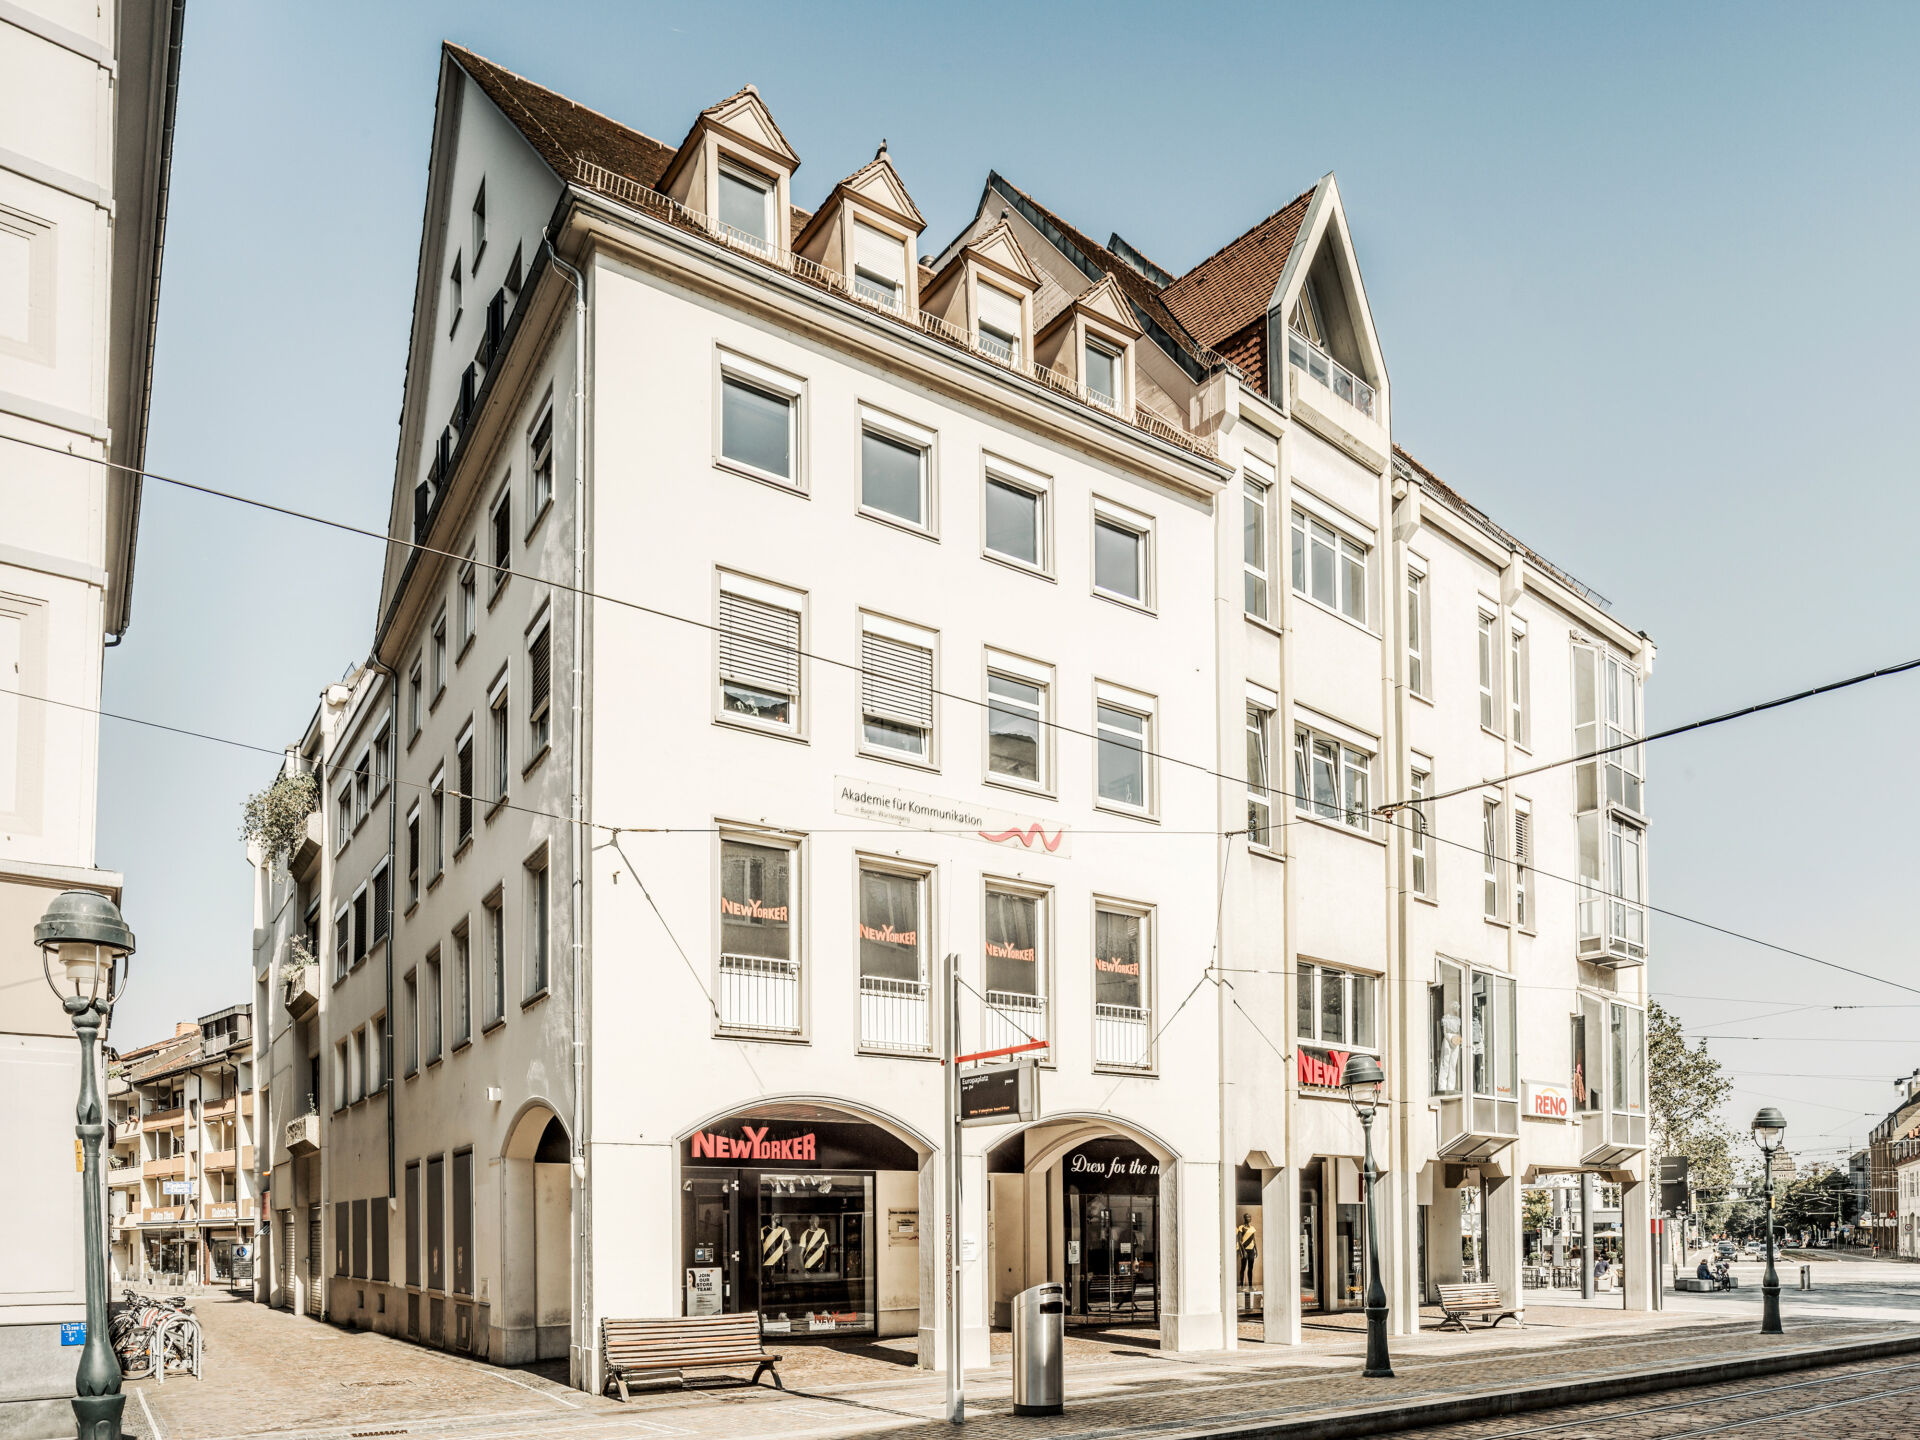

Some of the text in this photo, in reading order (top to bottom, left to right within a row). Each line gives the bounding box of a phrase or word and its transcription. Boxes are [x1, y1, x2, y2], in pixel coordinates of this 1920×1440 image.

[841, 787, 983, 827] Akademie für Kommunikation
[1535, 1094, 1567, 1117] RENO
[1070, 1153, 1105, 1173] Dress
[1104, 1156, 1126, 1178] for
[1129, 1158, 1147, 1175] the
